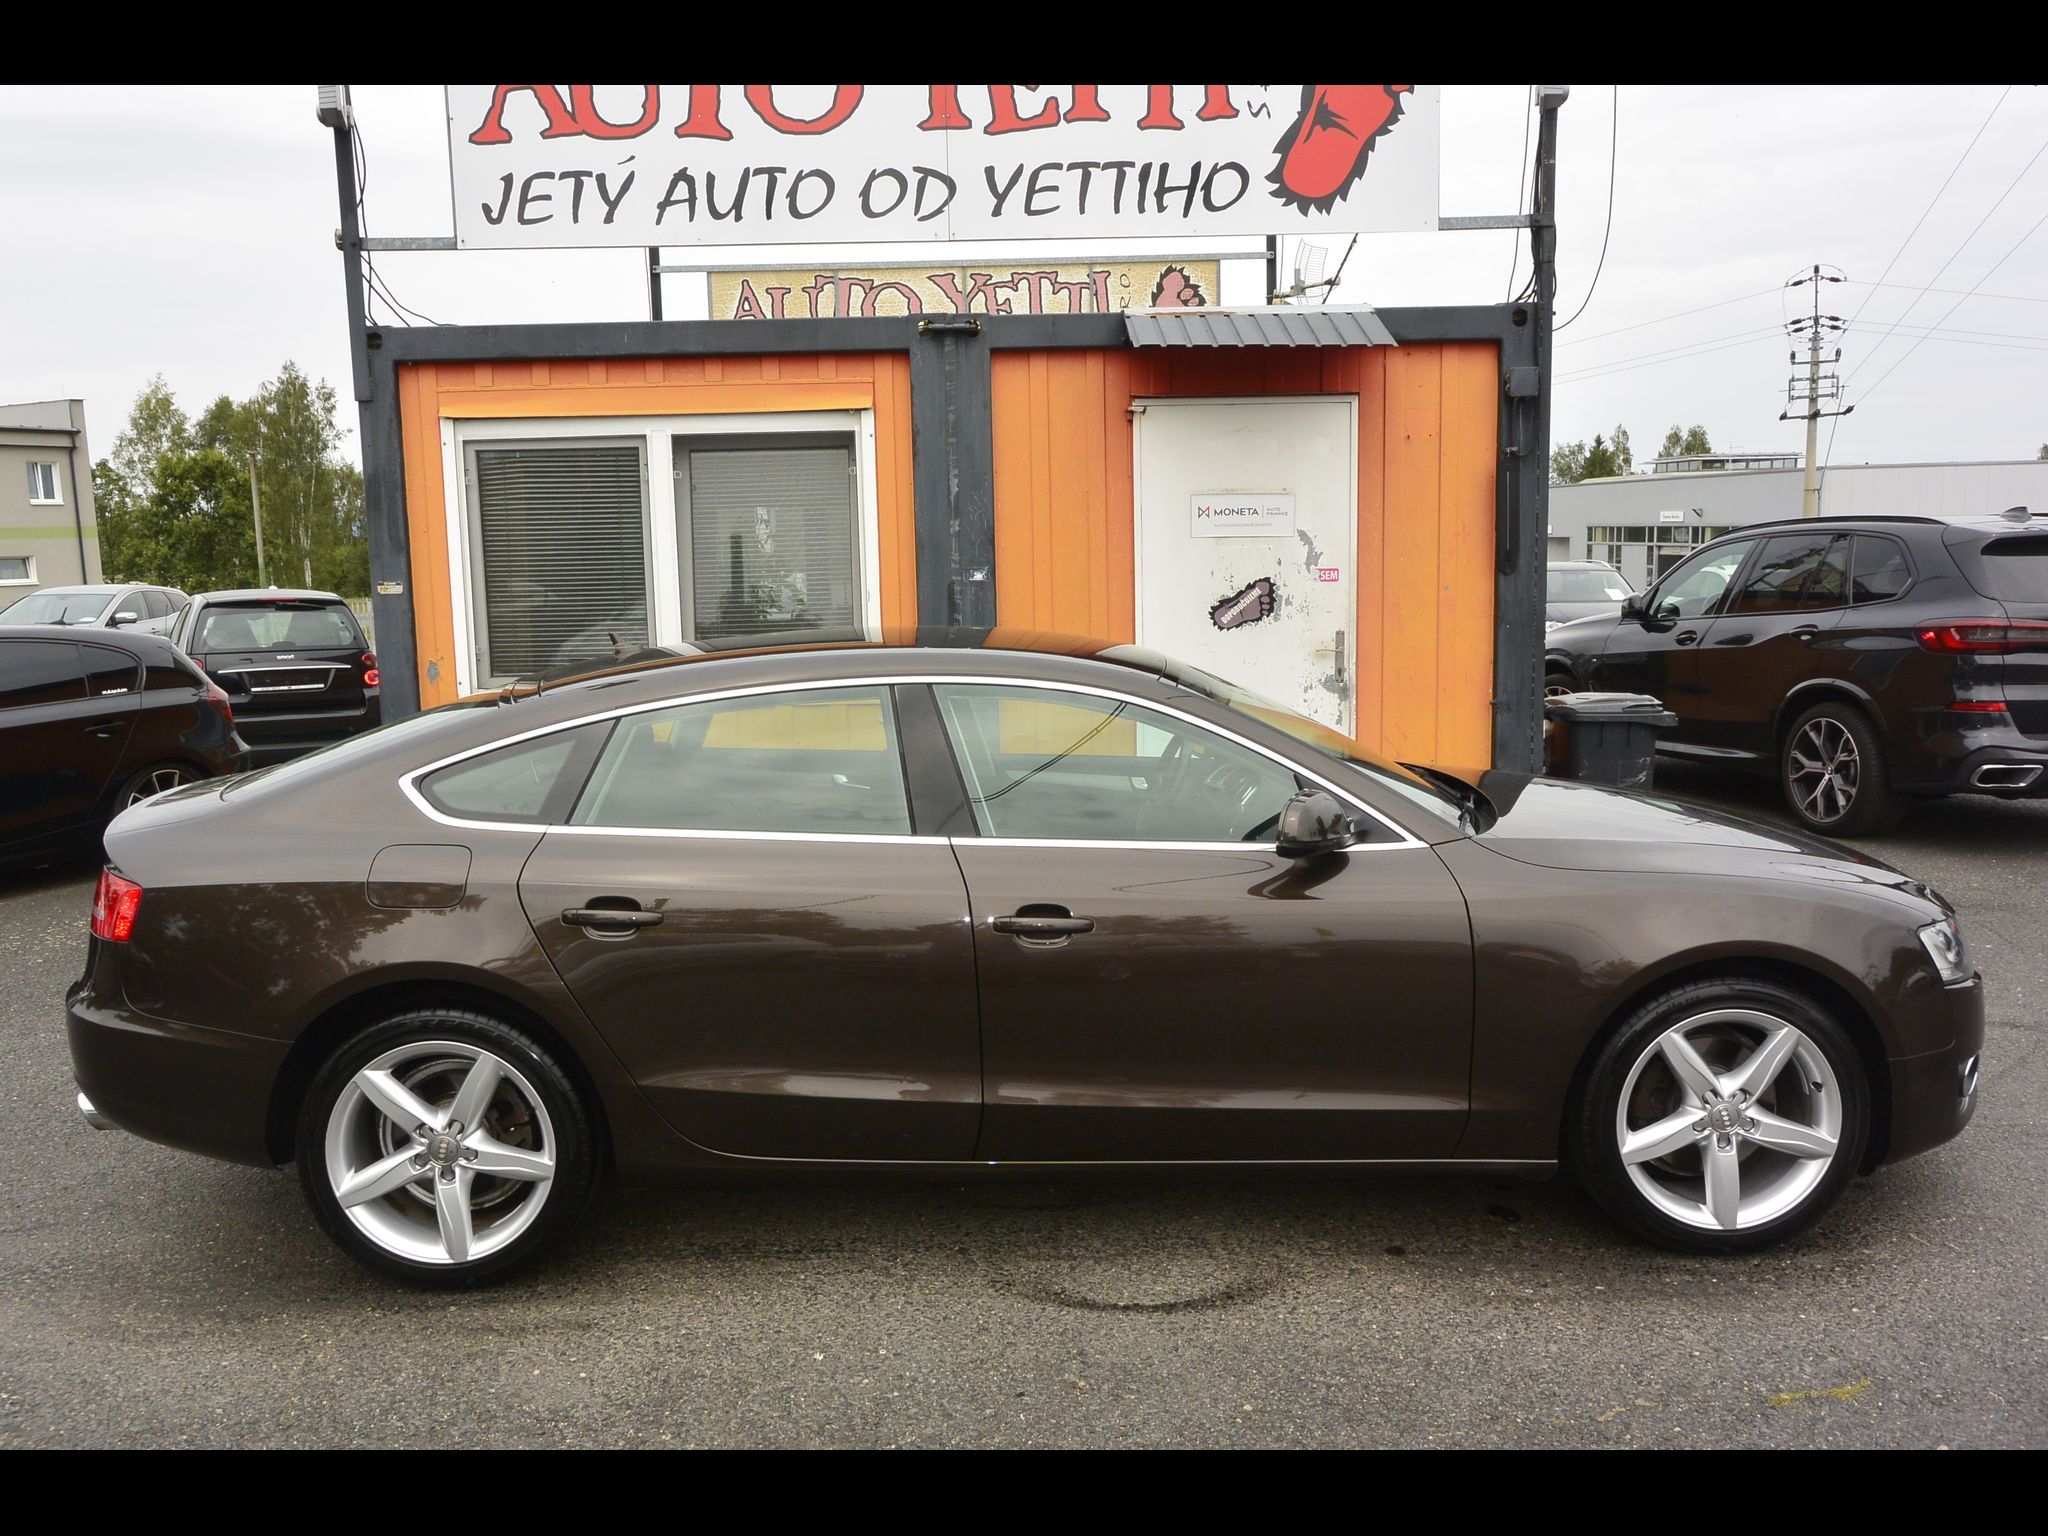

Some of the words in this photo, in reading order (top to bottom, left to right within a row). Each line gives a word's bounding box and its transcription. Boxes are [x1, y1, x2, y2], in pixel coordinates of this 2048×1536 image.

[481, 155, 636, 226] JETÝ
[655, 166, 836, 226] AUTO
[858, 166, 957, 222] OD
[984, 160, 1250, 219] YETTIHO
[1214, 508, 1259, 516] MONETA
[1320, 570, 1338, 580] SEM
